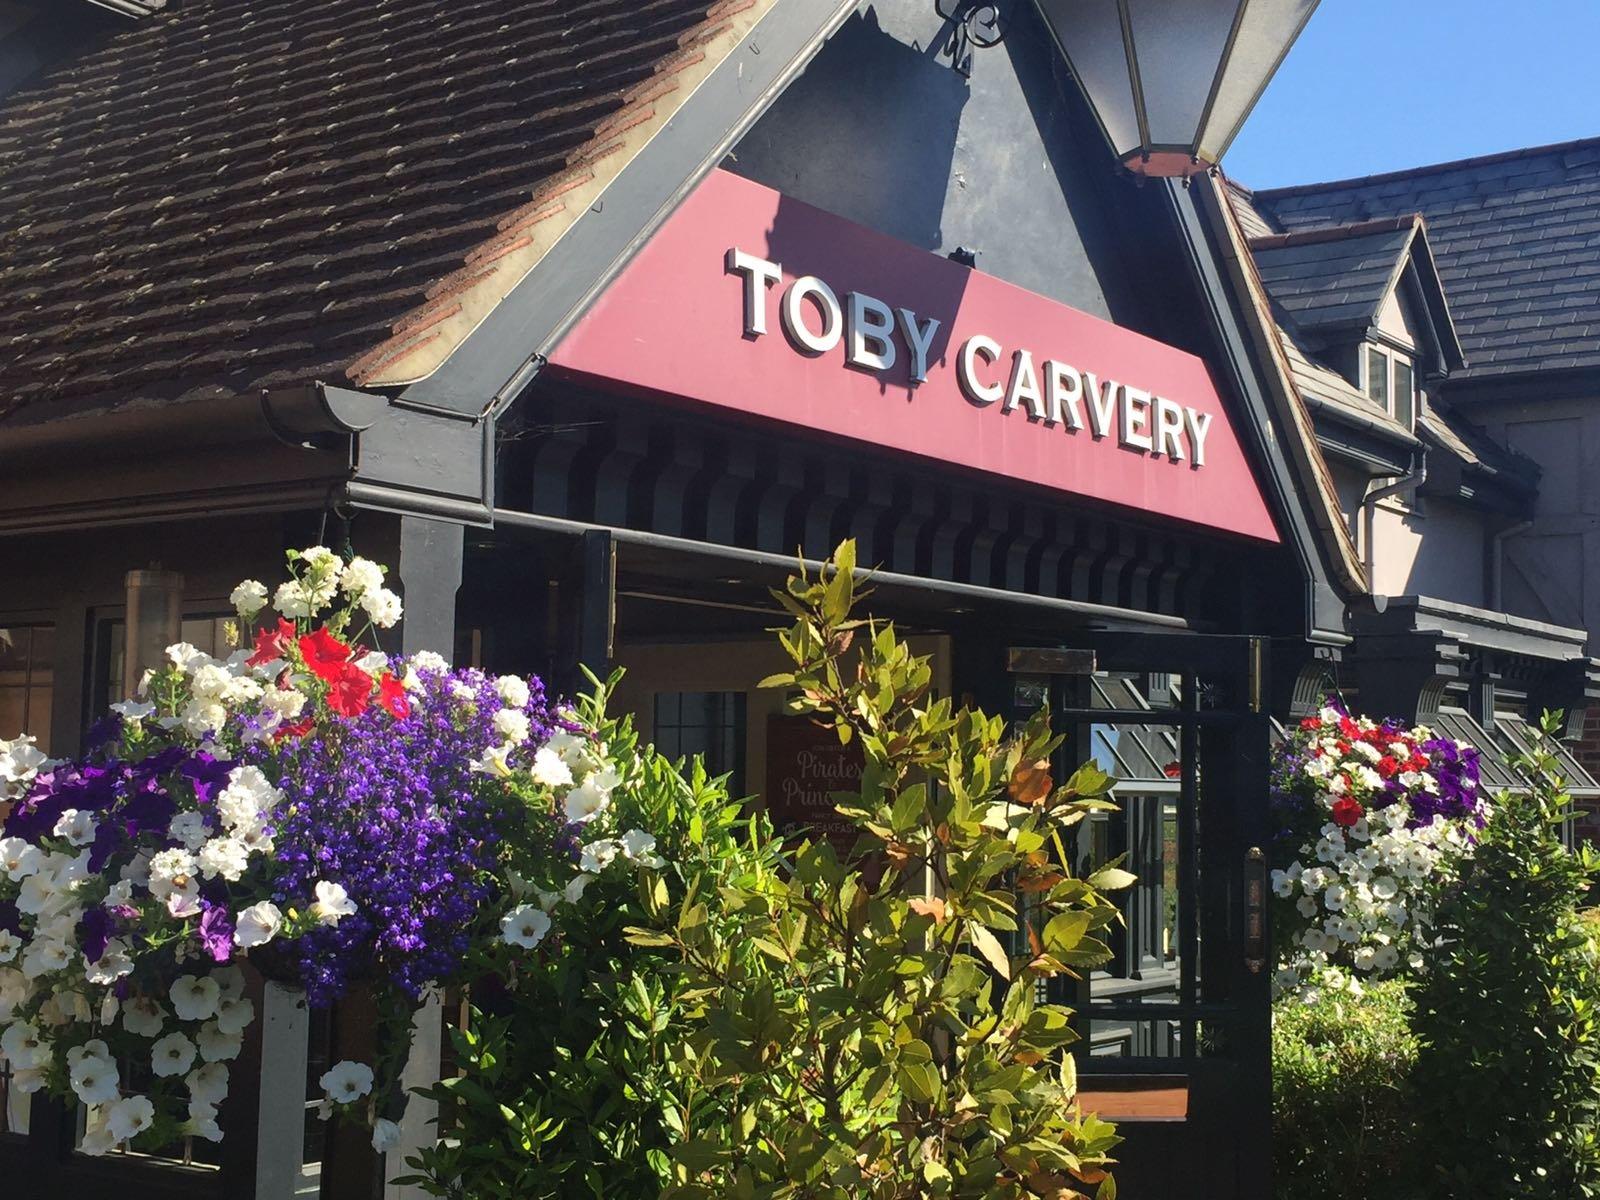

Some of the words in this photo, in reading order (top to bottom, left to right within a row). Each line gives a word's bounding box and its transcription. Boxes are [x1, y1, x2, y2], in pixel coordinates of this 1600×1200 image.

[726, 247, 941, 385] TOBY
[958, 335, 1213, 469] CARVERY
[797, 751, 862, 780] Pirates
[782, 777, 834, 807] Princ
